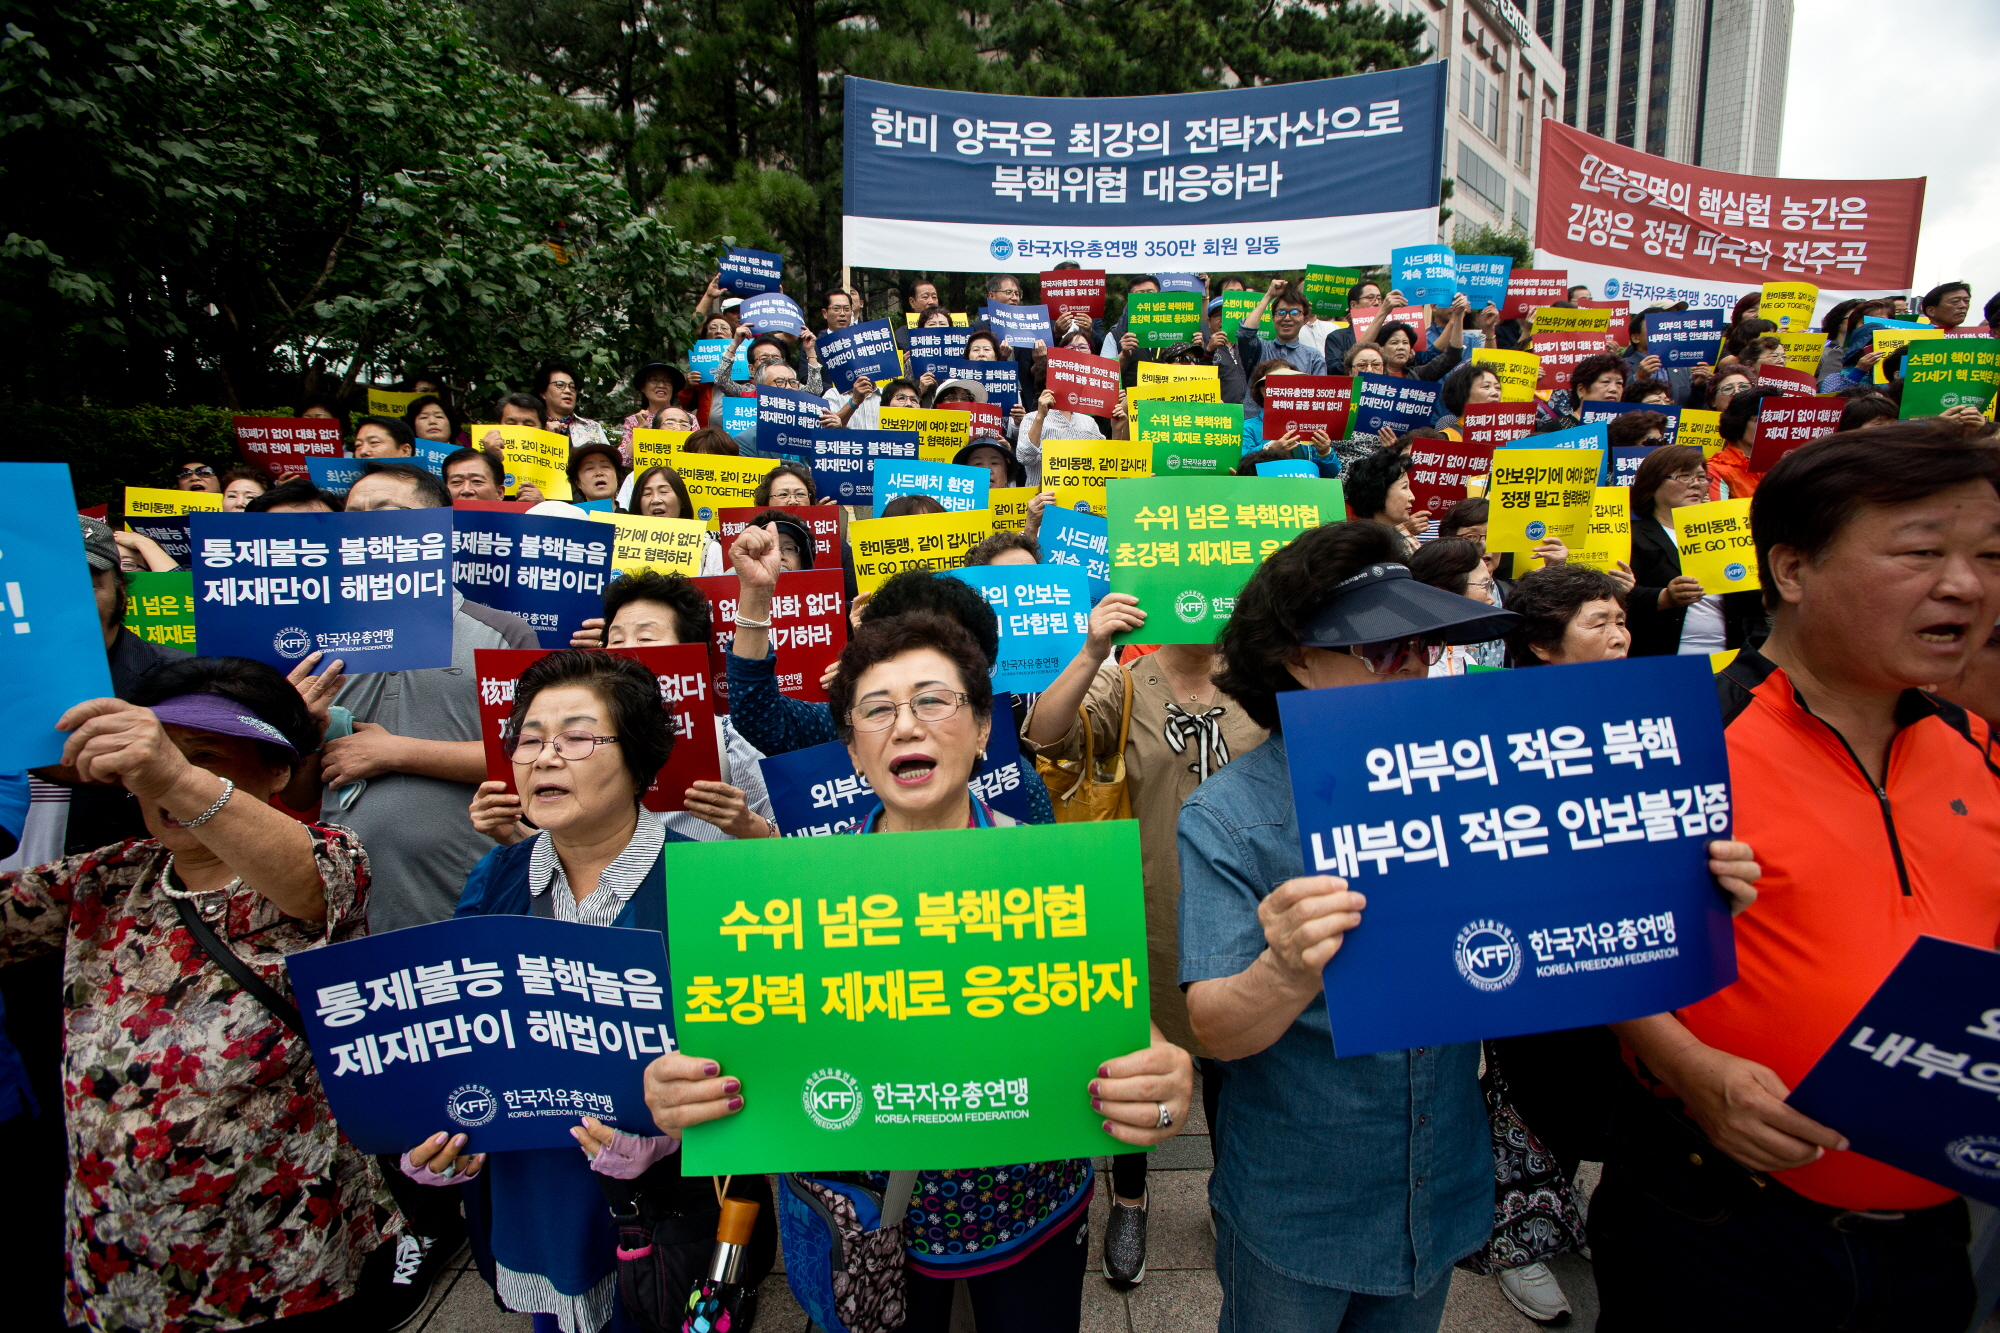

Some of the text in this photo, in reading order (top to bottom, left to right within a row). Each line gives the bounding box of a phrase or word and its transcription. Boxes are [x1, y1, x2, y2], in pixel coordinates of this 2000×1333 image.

[870, 100, 1403, 158] 한미 양국은 최강의 전략자산으로
[992, 162, 1282, 203] 북핵위협 대응하라
[1699, 187, 1771, 228] 핵실험
[1780, 196, 1867, 230] 농간은
[1018, 236, 1281, 258] 한국자유총연맹 350만 회원 일동
[1567, 203, 1867, 275] 김정은 정권 파국의 전주곡
[720, 263, 737, 272] 내부의
[738, 265, 751, 273] 적은
[728, 254, 773, 268] 외부의 적은 북핵
[1403, 254, 1442, 266] 사드배치
[1041, 279, 1105, 288] 한국자유총연맹 350만 회원
[1402, 269, 1421, 281] 계속
[1047, 289, 1063, 297] 북핵에
[1088, 288, 1099, 296] 없다!
[1622, 281, 1700, 306] 한국자유총연맹
[1704, 293, 1738, 309] 350만
[1137, 302, 1194, 311] 수위 넘은 북핵위협
[1130, 314, 1200, 323] 초강력 제재로 응징하자
[1536, 316, 1576, 327] 안보위기에
[1658, 320, 1713, 331] 외부의 적은 북핵
[820, 328, 890, 357] 통제불능 불핵놀음
[1649, 331, 1721, 343] 내부의 적은 안보불감증
[826, 341, 893, 369] 제재만이 해법이다
[1908, 353, 1947, 366] 소련이
[1951, 352, 1974, 364] 핵이
[1978, 352, 1994, 365] 없어
[1912, 370, 1952, 383] 21세기
[1956, 369, 1967, 381] 핵
[1970, 370, 1993, 384] 도박은
[1266, 388, 1351, 398] 한국자유총연맹 350만 회원
[1400, 388, 1436, 403] 불핵놀음
[1272, 400, 1342, 411] 북핵에 굴종 절대 없다!
[1396, 403, 1432, 417] 해법이다
[1150, 415, 1232, 429] 수위 넘은 북핵위협
[1797, 410, 1816, 422] 없이
[271, 428, 339, 440] 없이 대화 없다
[881, 418, 967, 433] 안보위기에 여야 없다
[1790, 427, 1809, 439] 전에
[1173, 432, 1241, 446] 제재로 응징하자
[270, 443, 291, 454] 전에
[521, 440, 563, 458] 같이 갑시다!
[815, 440, 916, 456] 통제불능 불핵놀음
[635, 458, 663, 466] WE GO
[815, 459, 863, 472] 제재만이
[1049, 457, 1147, 472] 한미동맹, 같이 갑시다!
[720, 472, 739, 483] 같이
[888, 473, 974, 494] 사드배치 환영
[1044, 476, 1079, 486] WE GO
[1495, 467, 1582, 485] 안보위기에 여야
[1501, 491, 1560, 508] 정쟁 말고
[1134, 504, 1320, 530] 수위 넘은 북핵위협
[1684, 518, 1741, 538] 한미동맹,
[650, 531, 701, 548] 여야 없다
[860, 531, 985, 556] 한미동맹, 같이 갑시다!
[201, 532, 445, 568] 통제불능 불핵놀음
[520, 534, 607, 565] 불핵놀음
[645, 547, 692, 565] 협력하라
[1115, 540, 1253, 567] 초강력 제재로
[1680, 541, 1725, 556] WE GO
[857, 562, 897, 575] WE GO
[203, 571, 445, 606] 제재만이 해법이다
[517, 567, 604, 595] 해법이다
[1014, 584, 1071, 606] 안보는
[142, 596, 179, 615] 넘은
[806, 593, 841, 617] 없다
[1010, 613, 1069, 636] 단합된
[1366, 716, 1681, 795] 외부의 적은 북핵
[1311, 783, 1730, 878] 내부의 적은 안보불감증
[720, 885, 1087, 952] 수위 넘은 북핵위협
[1466, 912, 1677, 969] KFF 한국자유총연맹
[1536, 947, 1679, 978] KOREA FREEDOM FEDERATION
[316, 954, 663, 1028] 통제불능 불핵놀음
[685, 958, 1137, 1025] 초강력 제재로 응징하자
[330, 1010, 677, 1077] 제재만이 해법이다
[456, 1088, 613, 1114] KFF 한국자유총연맹
[813, 1078, 1028, 1111] KFF 한국자유총연맹
[575, 1110, 617, 1121] FEDERATION
[875, 1110, 1029, 1123] KOREA FREEDOM FEDERATION
